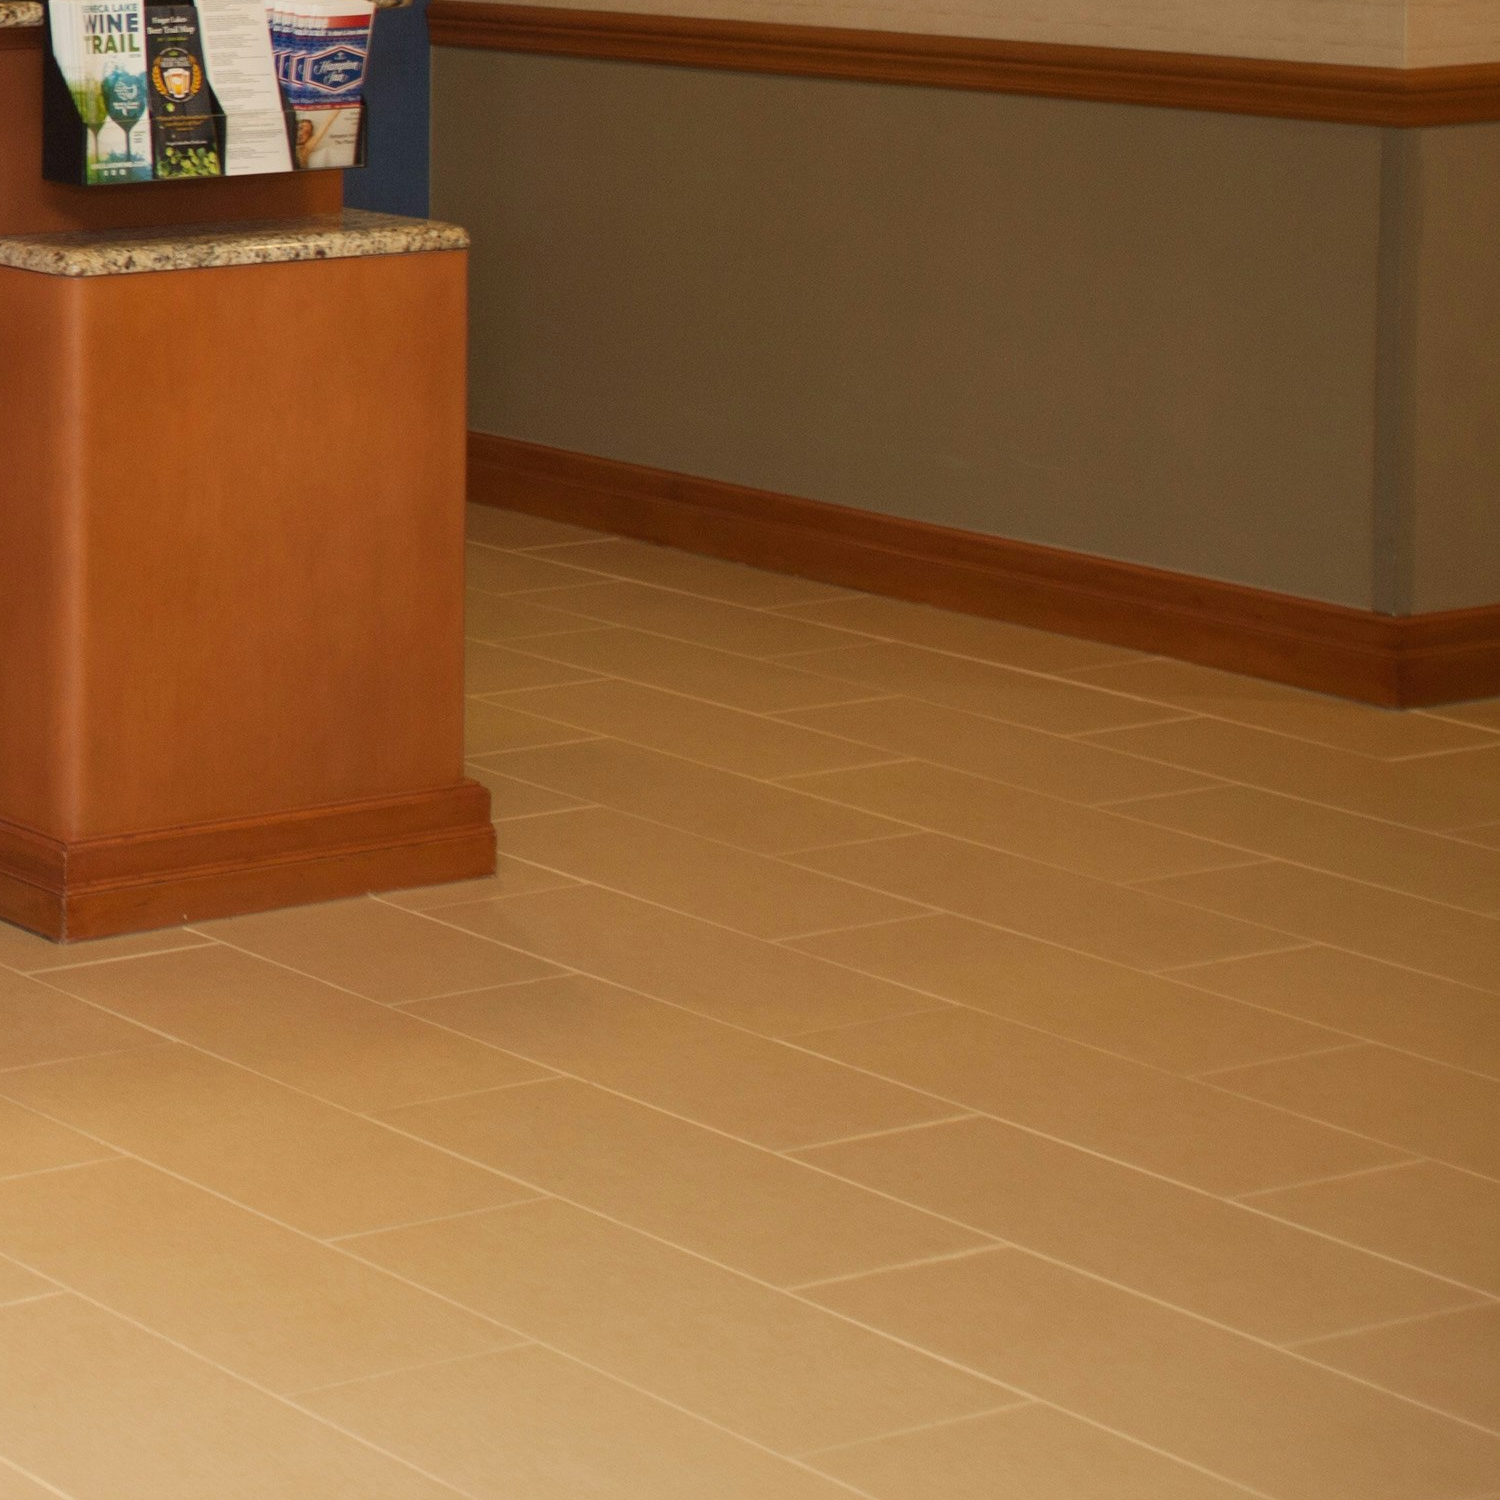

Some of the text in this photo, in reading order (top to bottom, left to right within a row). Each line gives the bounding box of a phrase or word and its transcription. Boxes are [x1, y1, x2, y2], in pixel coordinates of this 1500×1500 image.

[112, 3, 138, 12] LAKE
[84, 13, 139, 34] WINE
[84, 34, 140, 55] TRAIL
[314, 60, 361, 75] Hampton
